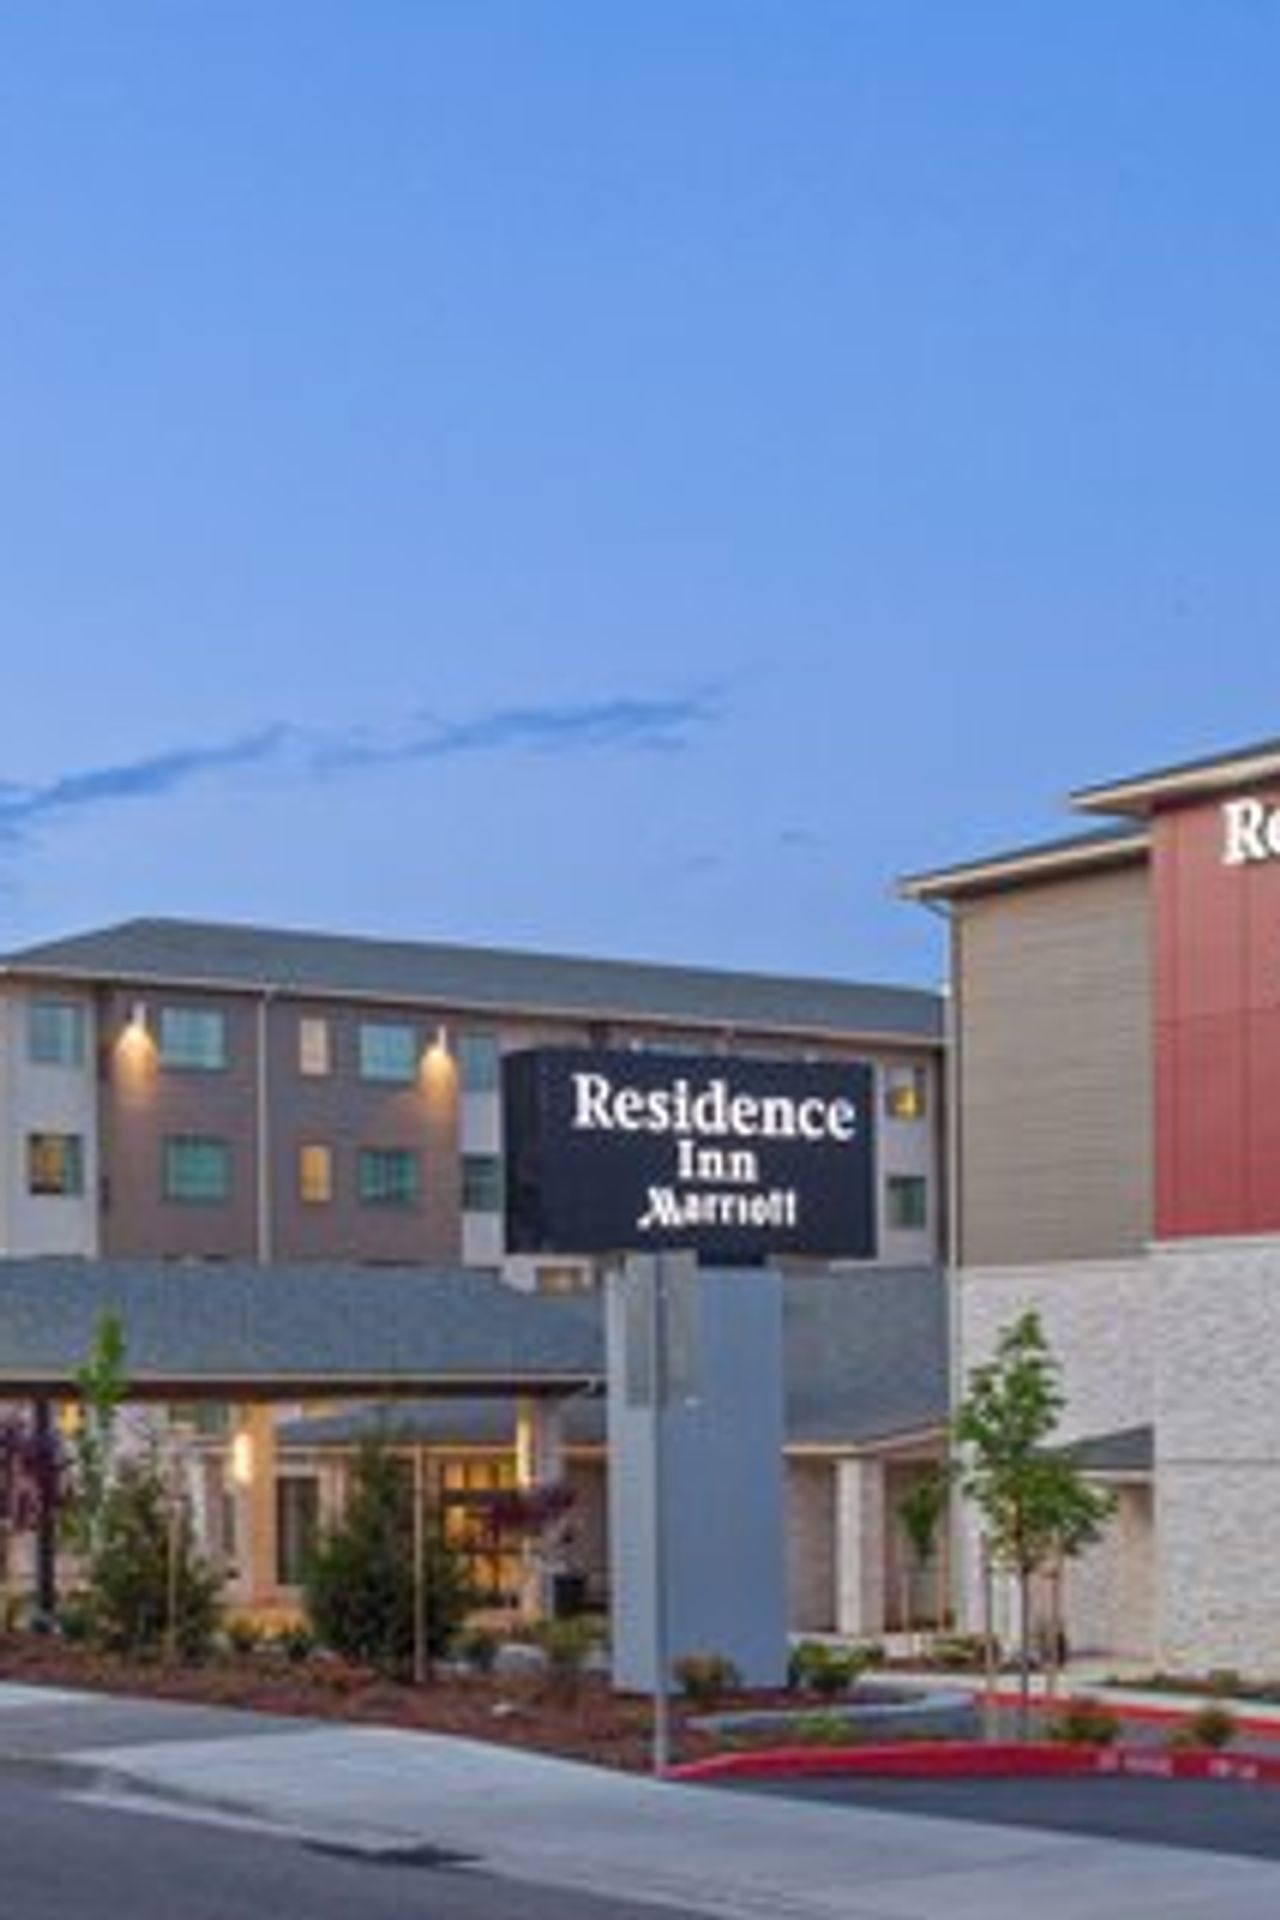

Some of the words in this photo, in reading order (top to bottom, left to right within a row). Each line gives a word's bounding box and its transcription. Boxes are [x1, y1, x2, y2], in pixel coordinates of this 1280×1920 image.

[573, 1073, 855, 1140] Residence
[677, 1139, 758, 1182] Inn
[636, 1186, 797, 1230] Marriott
